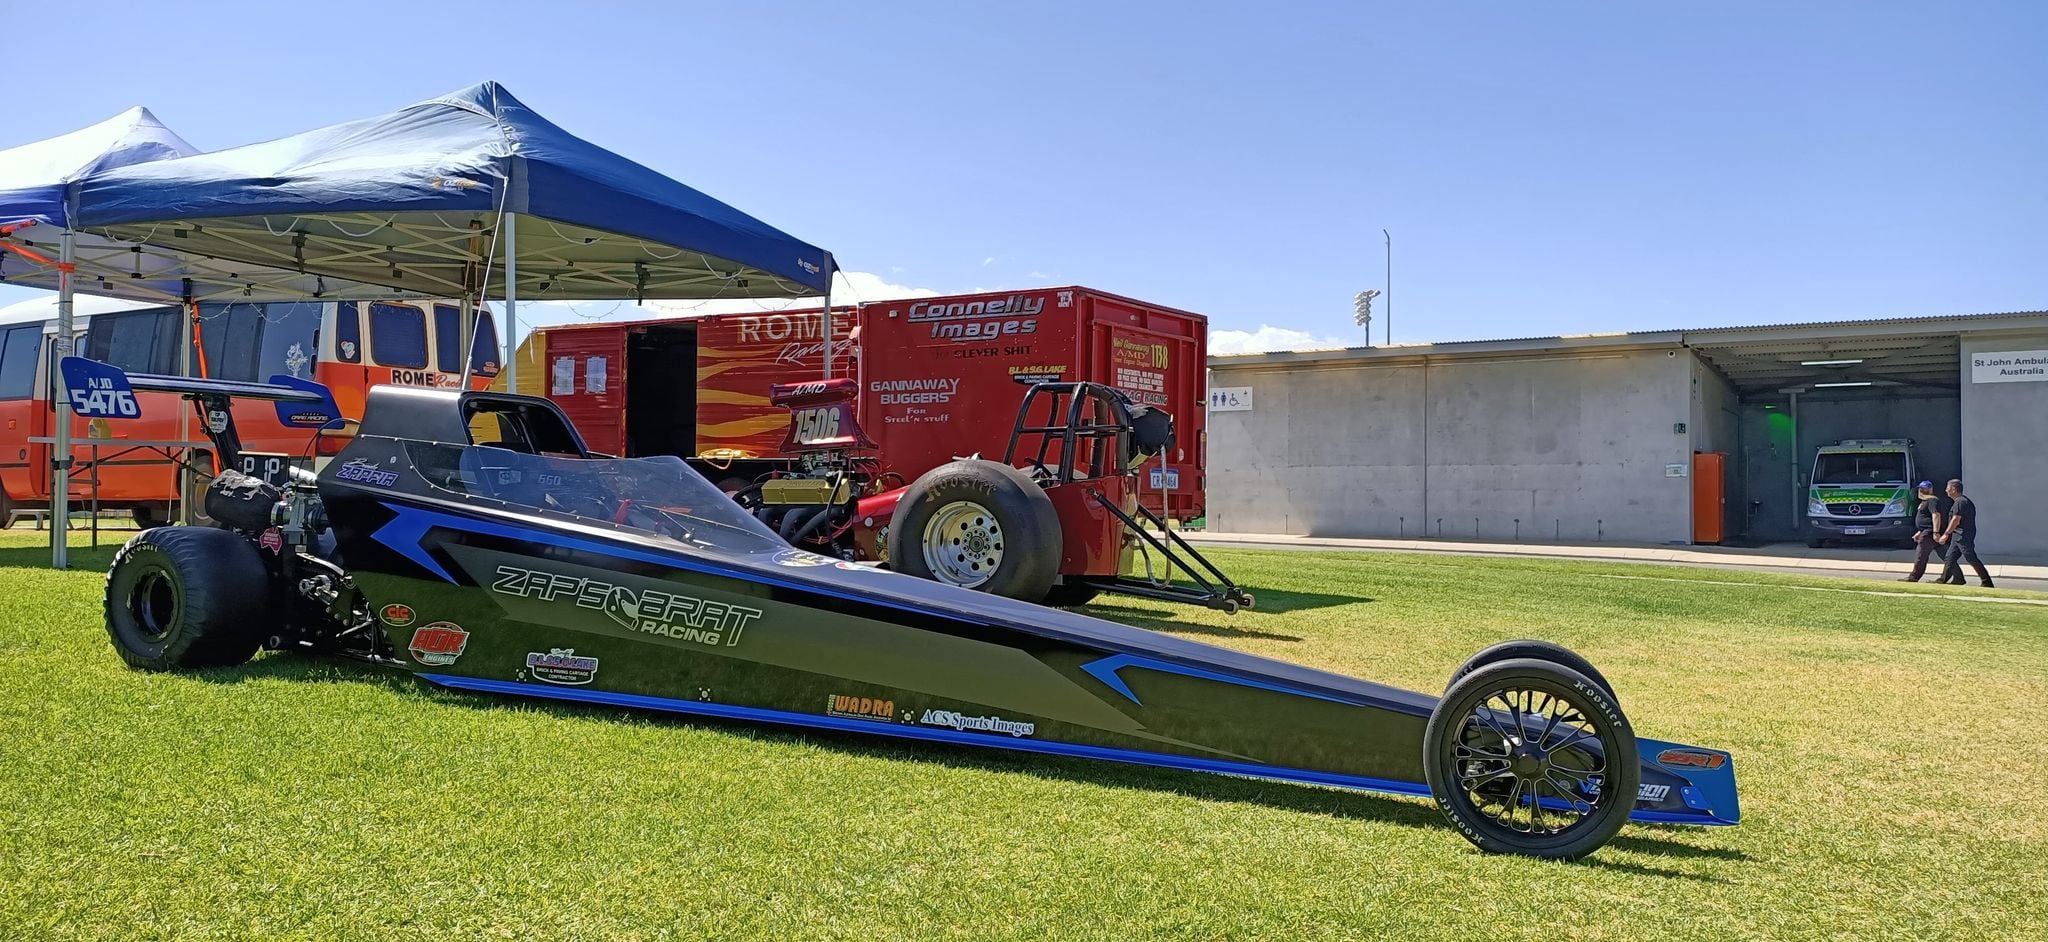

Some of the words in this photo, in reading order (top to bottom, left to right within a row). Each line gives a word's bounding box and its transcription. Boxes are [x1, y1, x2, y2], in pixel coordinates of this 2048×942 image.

[904, 295, 1044, 323] Connelly
[738, 313, 852, 342] ROME
[931, 319, 1037, 342] Images
[1004, 345, 1033, 356] SHIT
[1043, 365, 1068, 374] LAKE
[1974, 359, 1985, 367] St
[1987, 359, 2012, 367] John
[1999, 367, 2044, 376] Australia
[391, 370, 434, 387] ROME
[870, 378, 960, 394] GANNAWAY
[70, 389, 137, 416] 5476
[880, 391, 950, 405] BUGGERS
[792, 407, 840, 445] 1506
[638, 590, 762, 647] BRAT
[641, 621, 720, 646] RACING
[834, 695, 895, 717] WADRA
[920, 708, 951, 726] ACS
[951, 712, 990, 731] Sports
[990, 716, 1035, 737] Images
